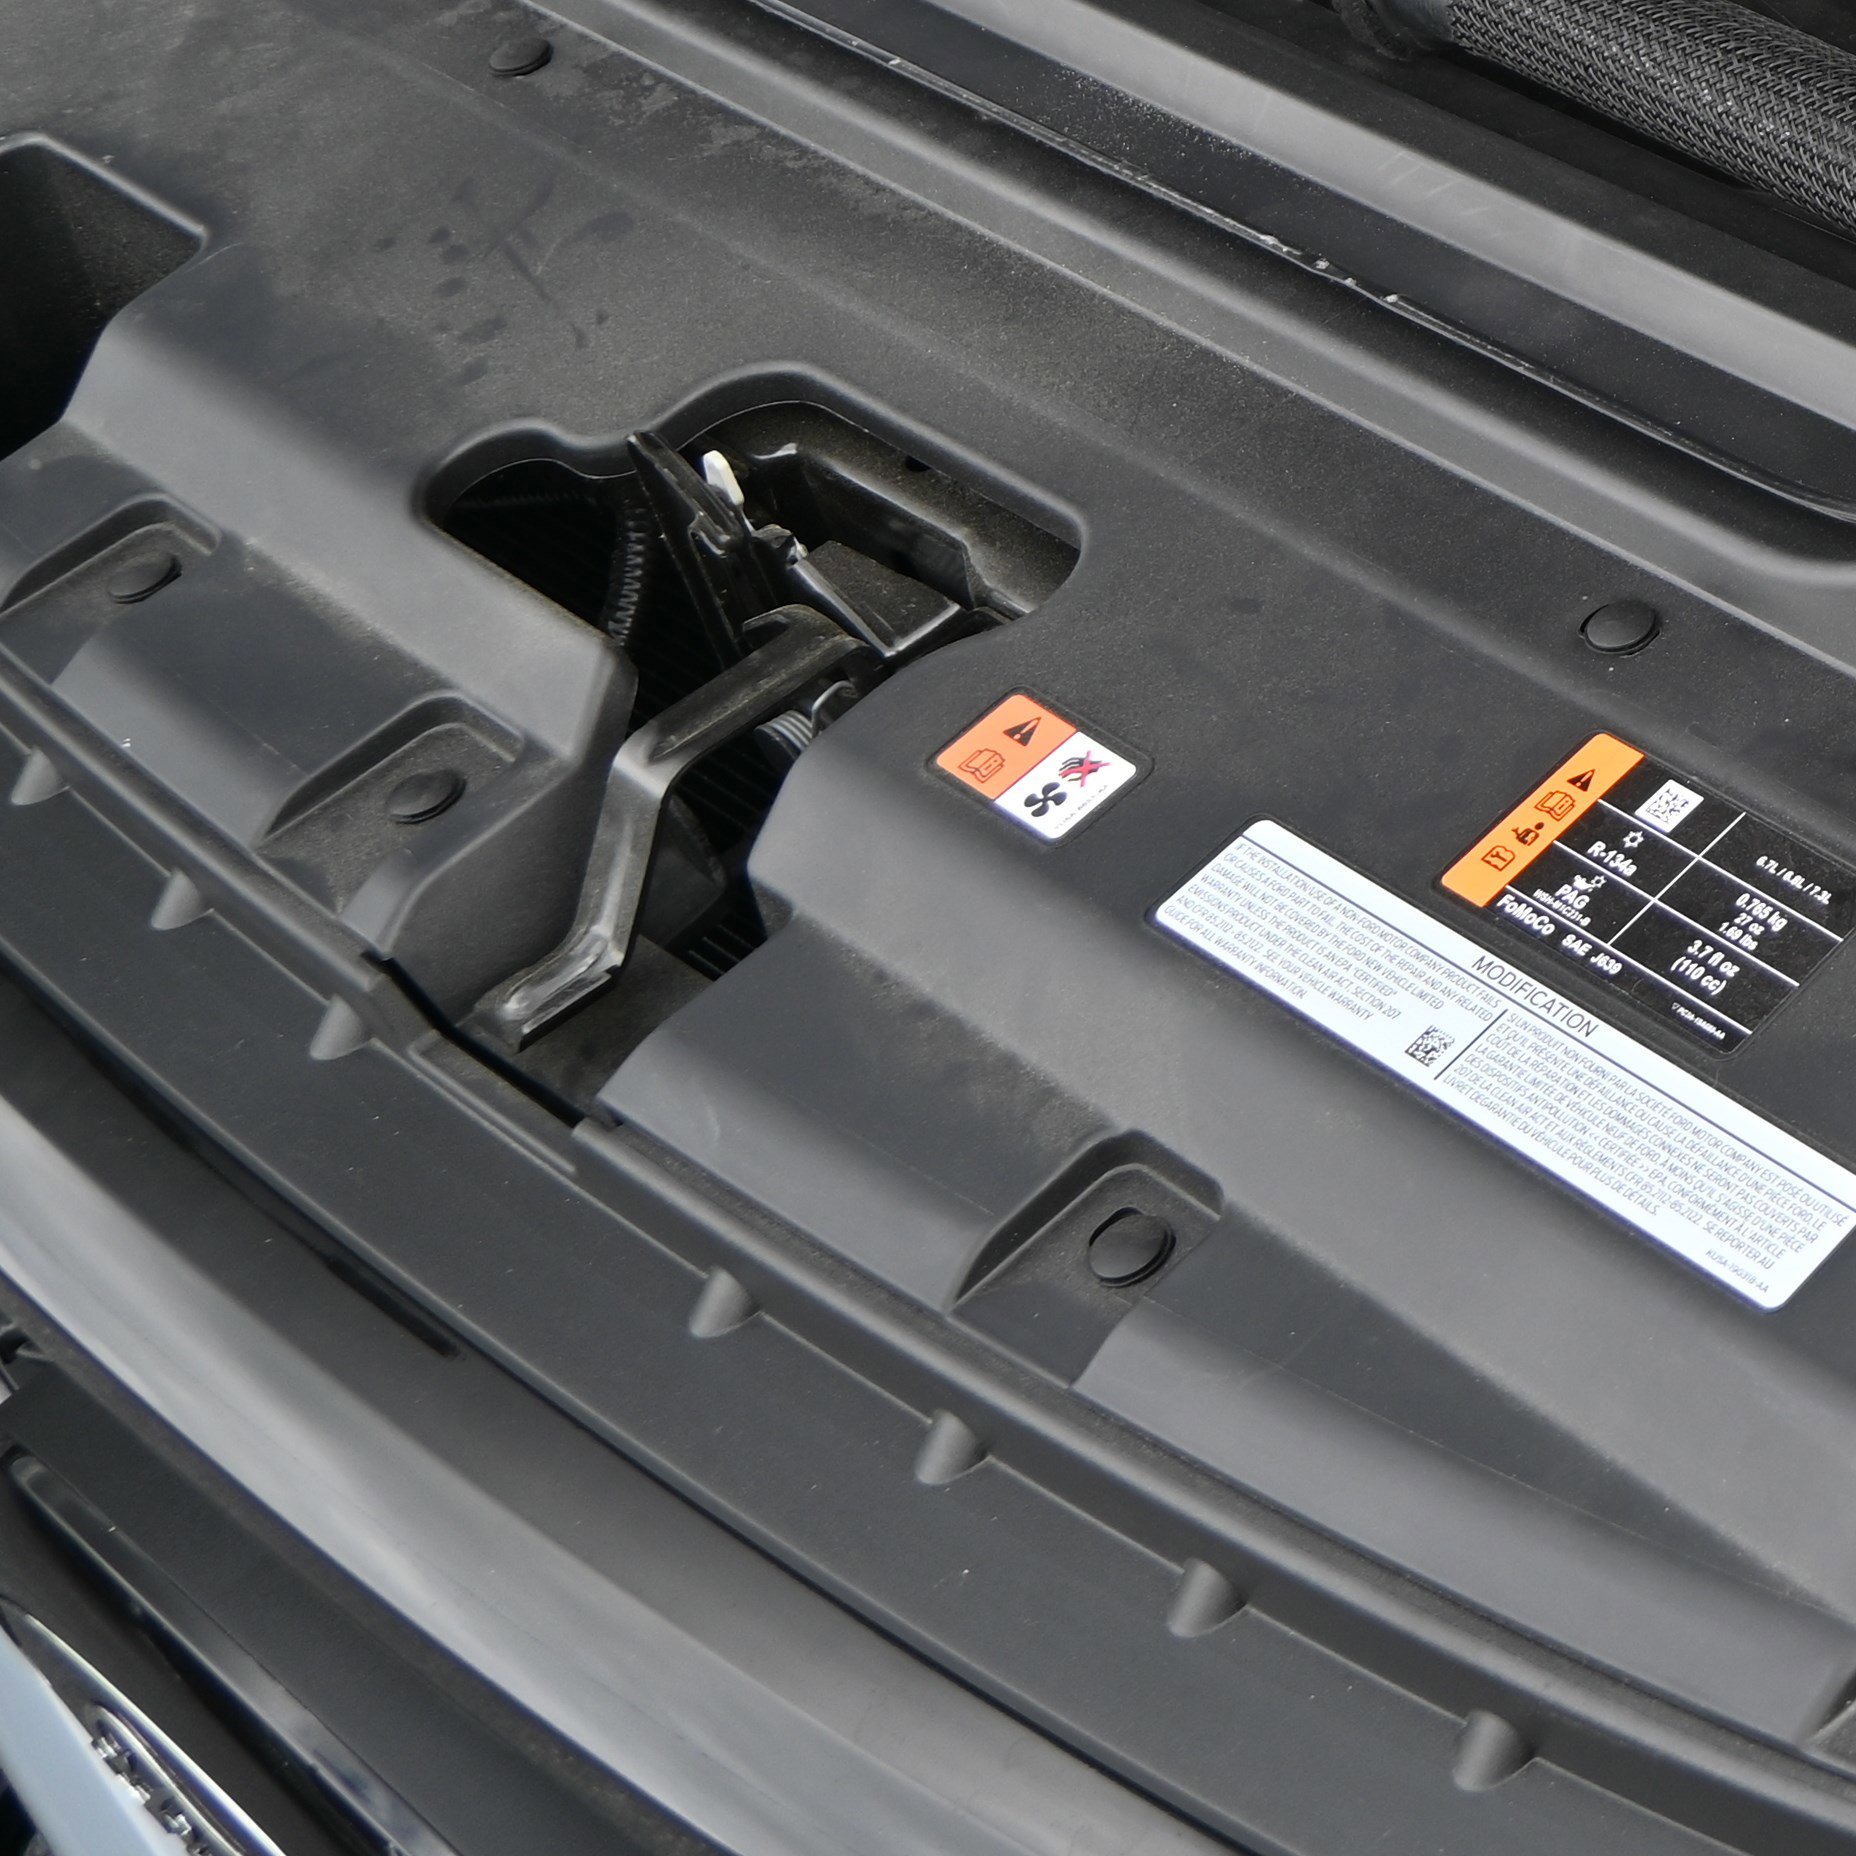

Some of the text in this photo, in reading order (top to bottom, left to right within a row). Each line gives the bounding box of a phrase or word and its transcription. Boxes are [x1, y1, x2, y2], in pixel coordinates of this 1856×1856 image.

[1584, 840, 1641, 877] R-134a
[1552, 883, 1592, 911] PAG
[1733, 892, 1791, 933] 0.765 kg
[1494, 893, 1625, 975] FoMoCo SAE J639
[1732, 913, 1766, 935] 27 oz
[1666, 955, 1729, 997] (110 cc)
[1684, 938, 1713, 960] 3.7
[1716, 957, 1744, 978] oz
[1469, 953, 1600, 1039] MODIFICATION
